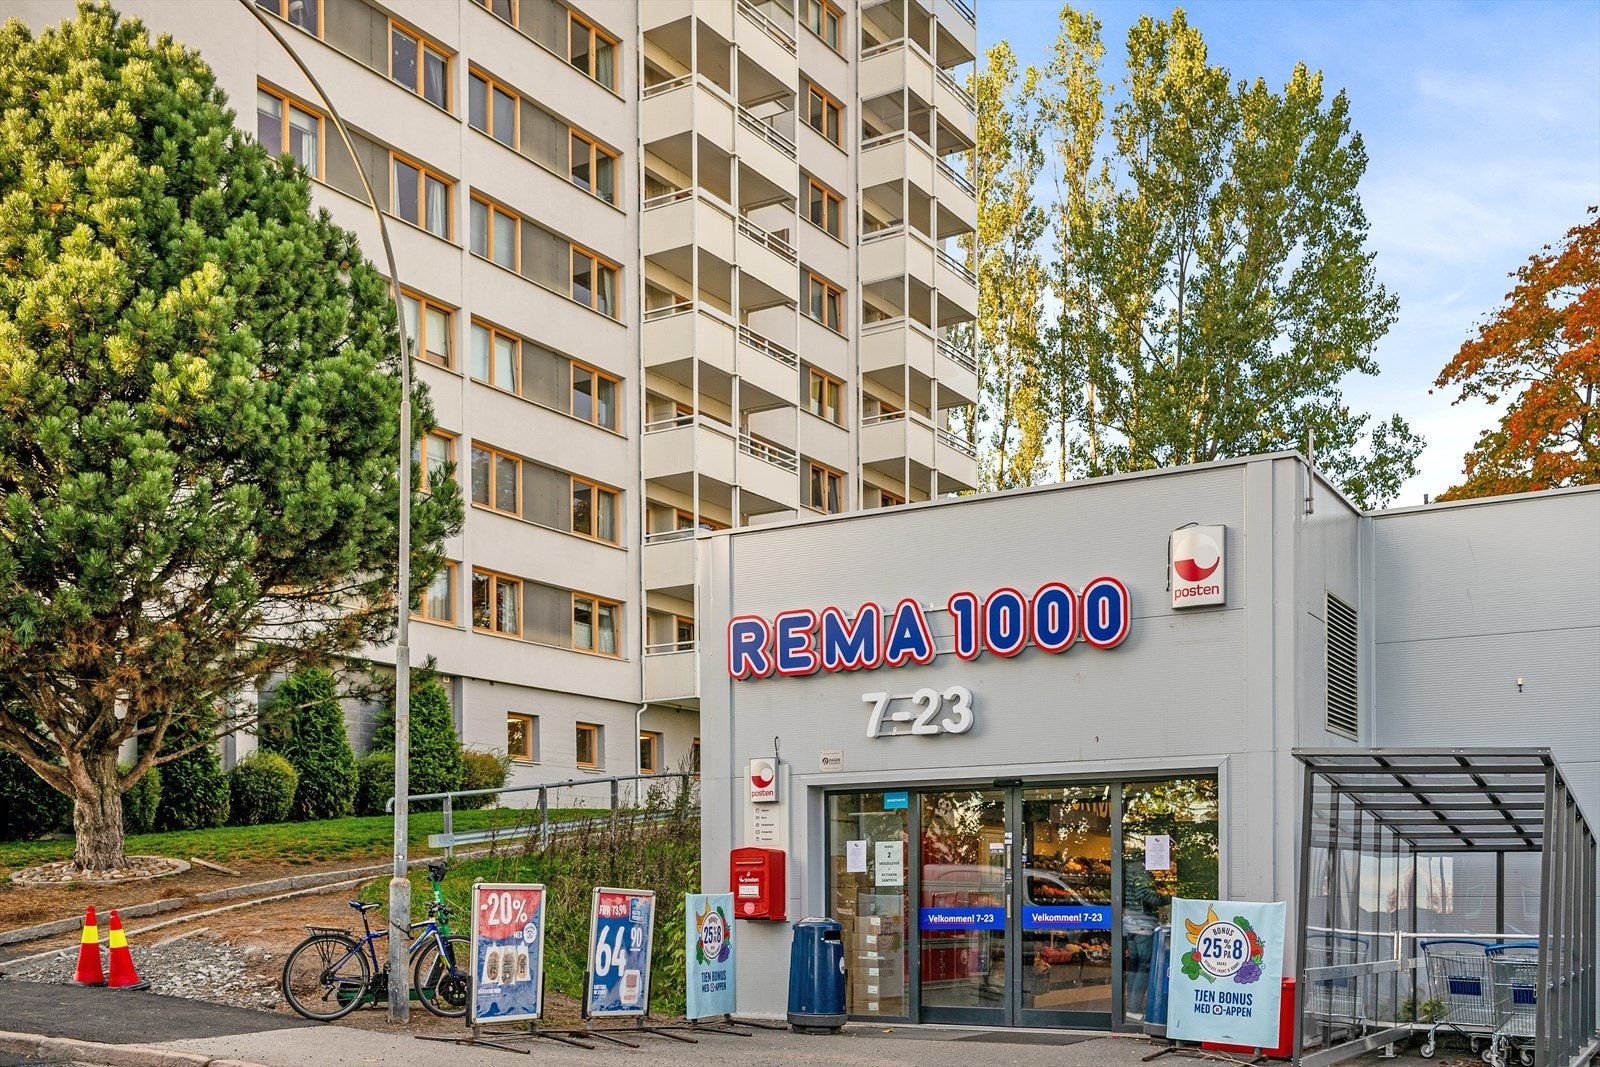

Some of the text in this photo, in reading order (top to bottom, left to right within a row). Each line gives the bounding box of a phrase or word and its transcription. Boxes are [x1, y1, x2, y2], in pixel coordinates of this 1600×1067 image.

[1174, 584, 1220, 601] posten
[727, 576, 1131, 681] REMA 1000
[861, 685, 974, 738] 7-23
[751, 790, 774, 798] posten
[887, 851, 892, 859] 2
[612, 904, 627, 917] 73,90
[928, 914, 994, 924] Velkommen! 7-23
[1032, 913, 1103, 923] Velkommen! 7-23
[1212, 926, 1235, 937] BONUS
[595, 925, 643, 977] 64 90
[1232, 939, 1243, 960] 8
[712, 970, 727, 982] BONUS
[1194, 989, 1253, 1006] TJEN BONUS
[1194, 1003, 1211, 1014] MED
